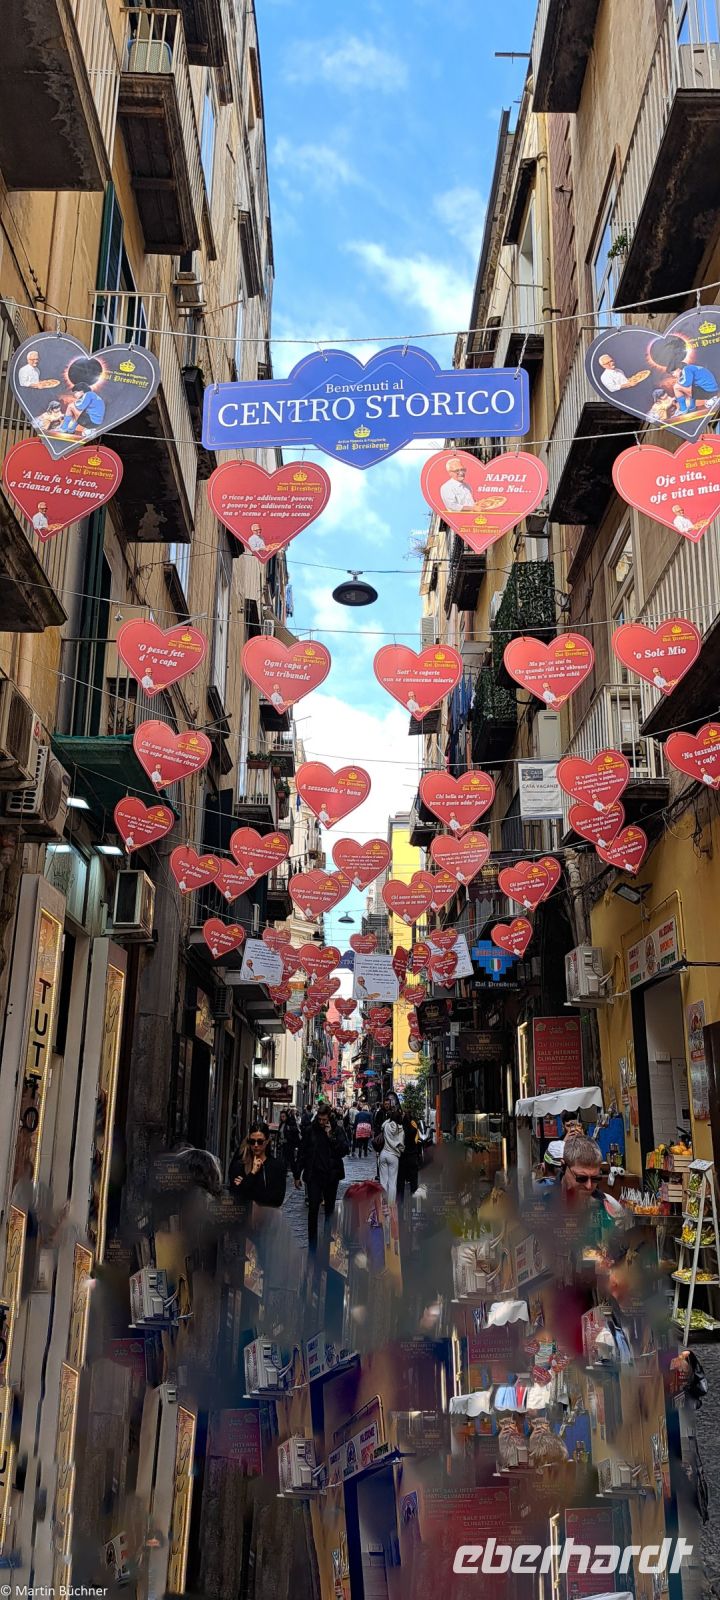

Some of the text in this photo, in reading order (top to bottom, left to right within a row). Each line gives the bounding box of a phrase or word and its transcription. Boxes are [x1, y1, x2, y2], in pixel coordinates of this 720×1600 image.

[326, 380, 404, 394] Benvenuti al
[218, 390, 515, 428] CENTRO STORICO
[352, 443, 390, 451] Presidente
[34, 470, 50, 482] lira
[52, 474, 62, 484] fa
[65, 476, 74, 486] 'o
[74, 478, 98, 489] ricco,
[485, 473, 527, 482] NAPOLI
[656, 471, 706, 487] Oje vita,
[18, 480, 50, 492] crianza
[51, 486, 63, 495] fa
[72, 489, 106, 500] signore
[477, 484, 504, 493] siamo
[650, 493, 668, 504] oje
[671, 488, 694, 500] vita
[147, 647, 168, 655] pesce
[169, 649, 185, 658] fete
[634, 646, 686, 659] 'o Sole Mio
[159, 659, 177, 668] capa
[264, 659, 283, 668] Ogni
[276, 670, 311, 680] tribunale
